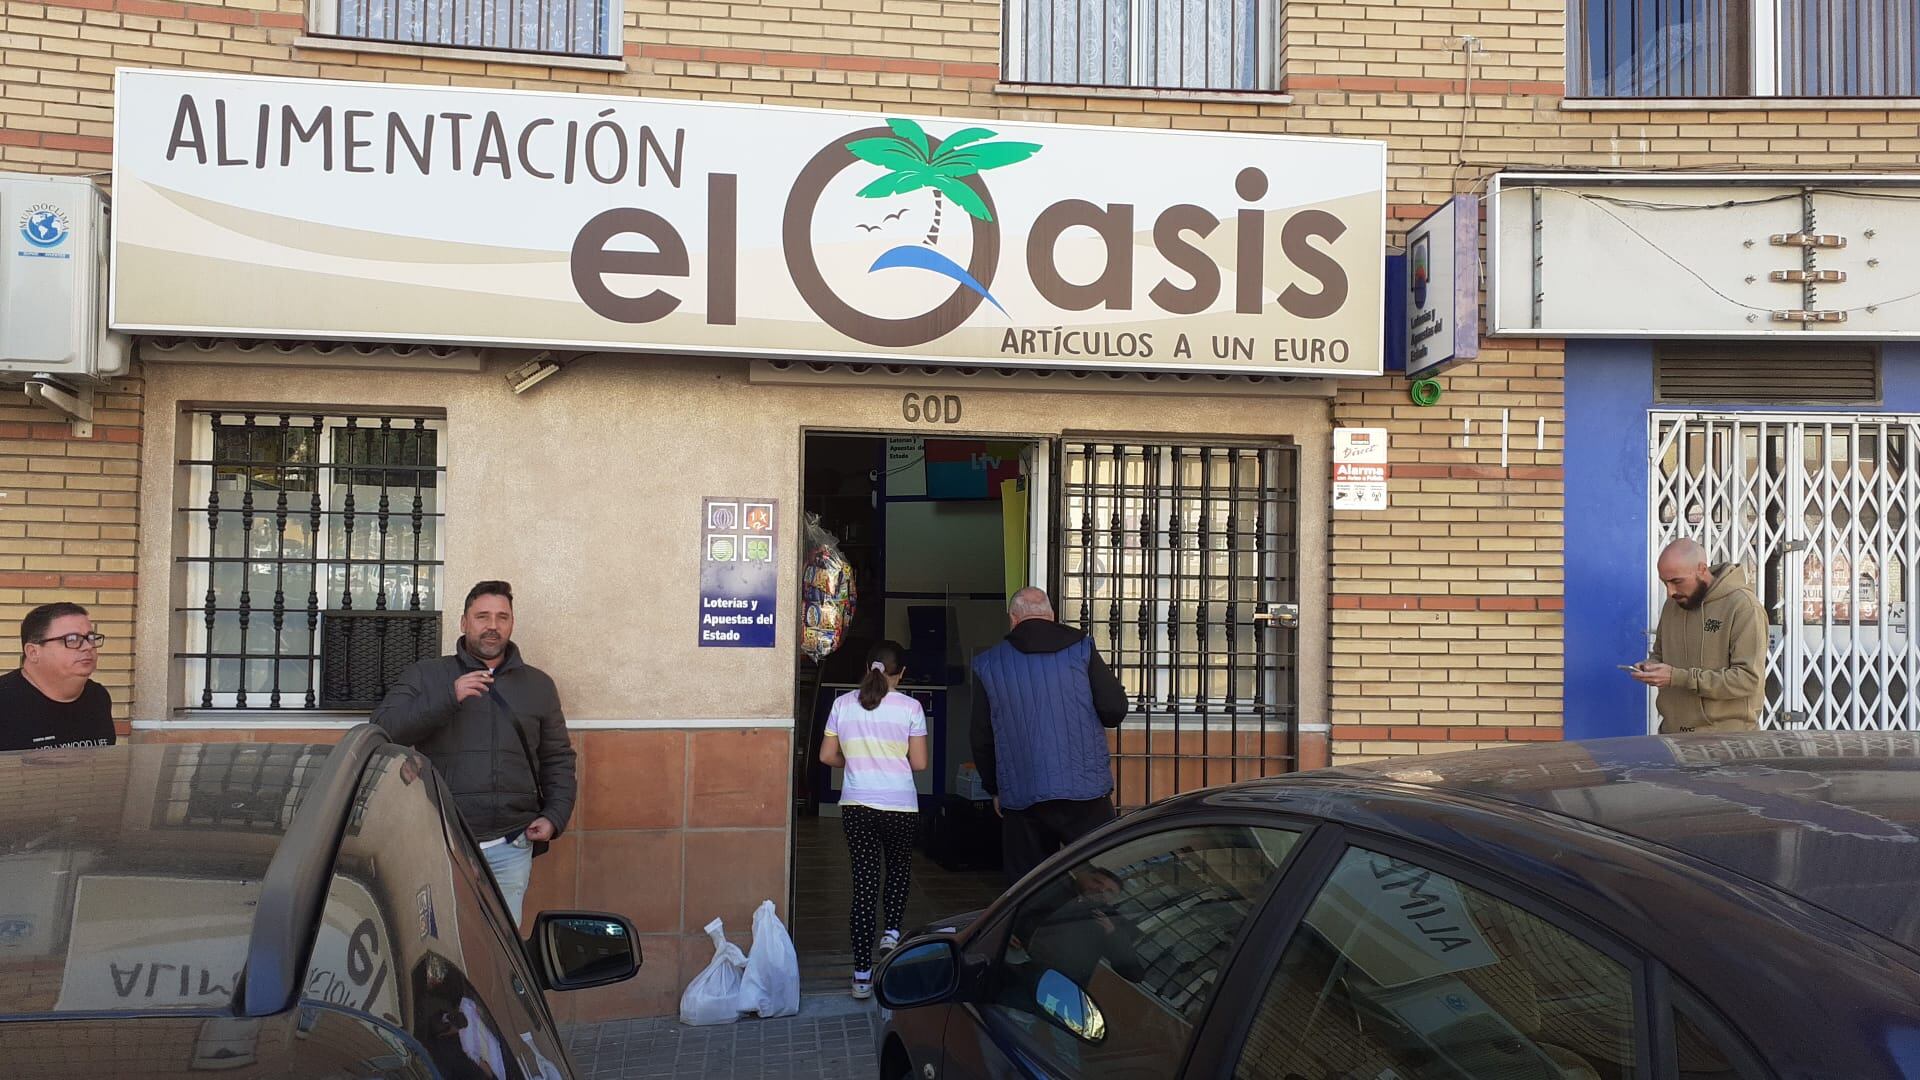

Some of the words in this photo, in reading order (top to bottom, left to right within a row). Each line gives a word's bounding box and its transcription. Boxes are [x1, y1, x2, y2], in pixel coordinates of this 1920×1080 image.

[166, 94, 685, 188] ALIMENTACIÓN
[19, 203, 69, 231] MUNDOCLIMA
[571, 172, 738, 326] el
[1001, 326, 1153, 358] ARTÍCULOS
[1173, 333, 1192, 359] A
[1212, 335, 1255, 361] UN
[1274, 337, 1350, 363] EURO
[902, 392, 962, 424] 60D
[1337, 464, 1385, 476] Alarma
[703, 597, 748, 609] Loterías
[751, 599, 758, 611] y
[703, 613, 753, 626] Apuestas
[756, 613, 773, 625] del
[702, 629, 741, 641] Estado
